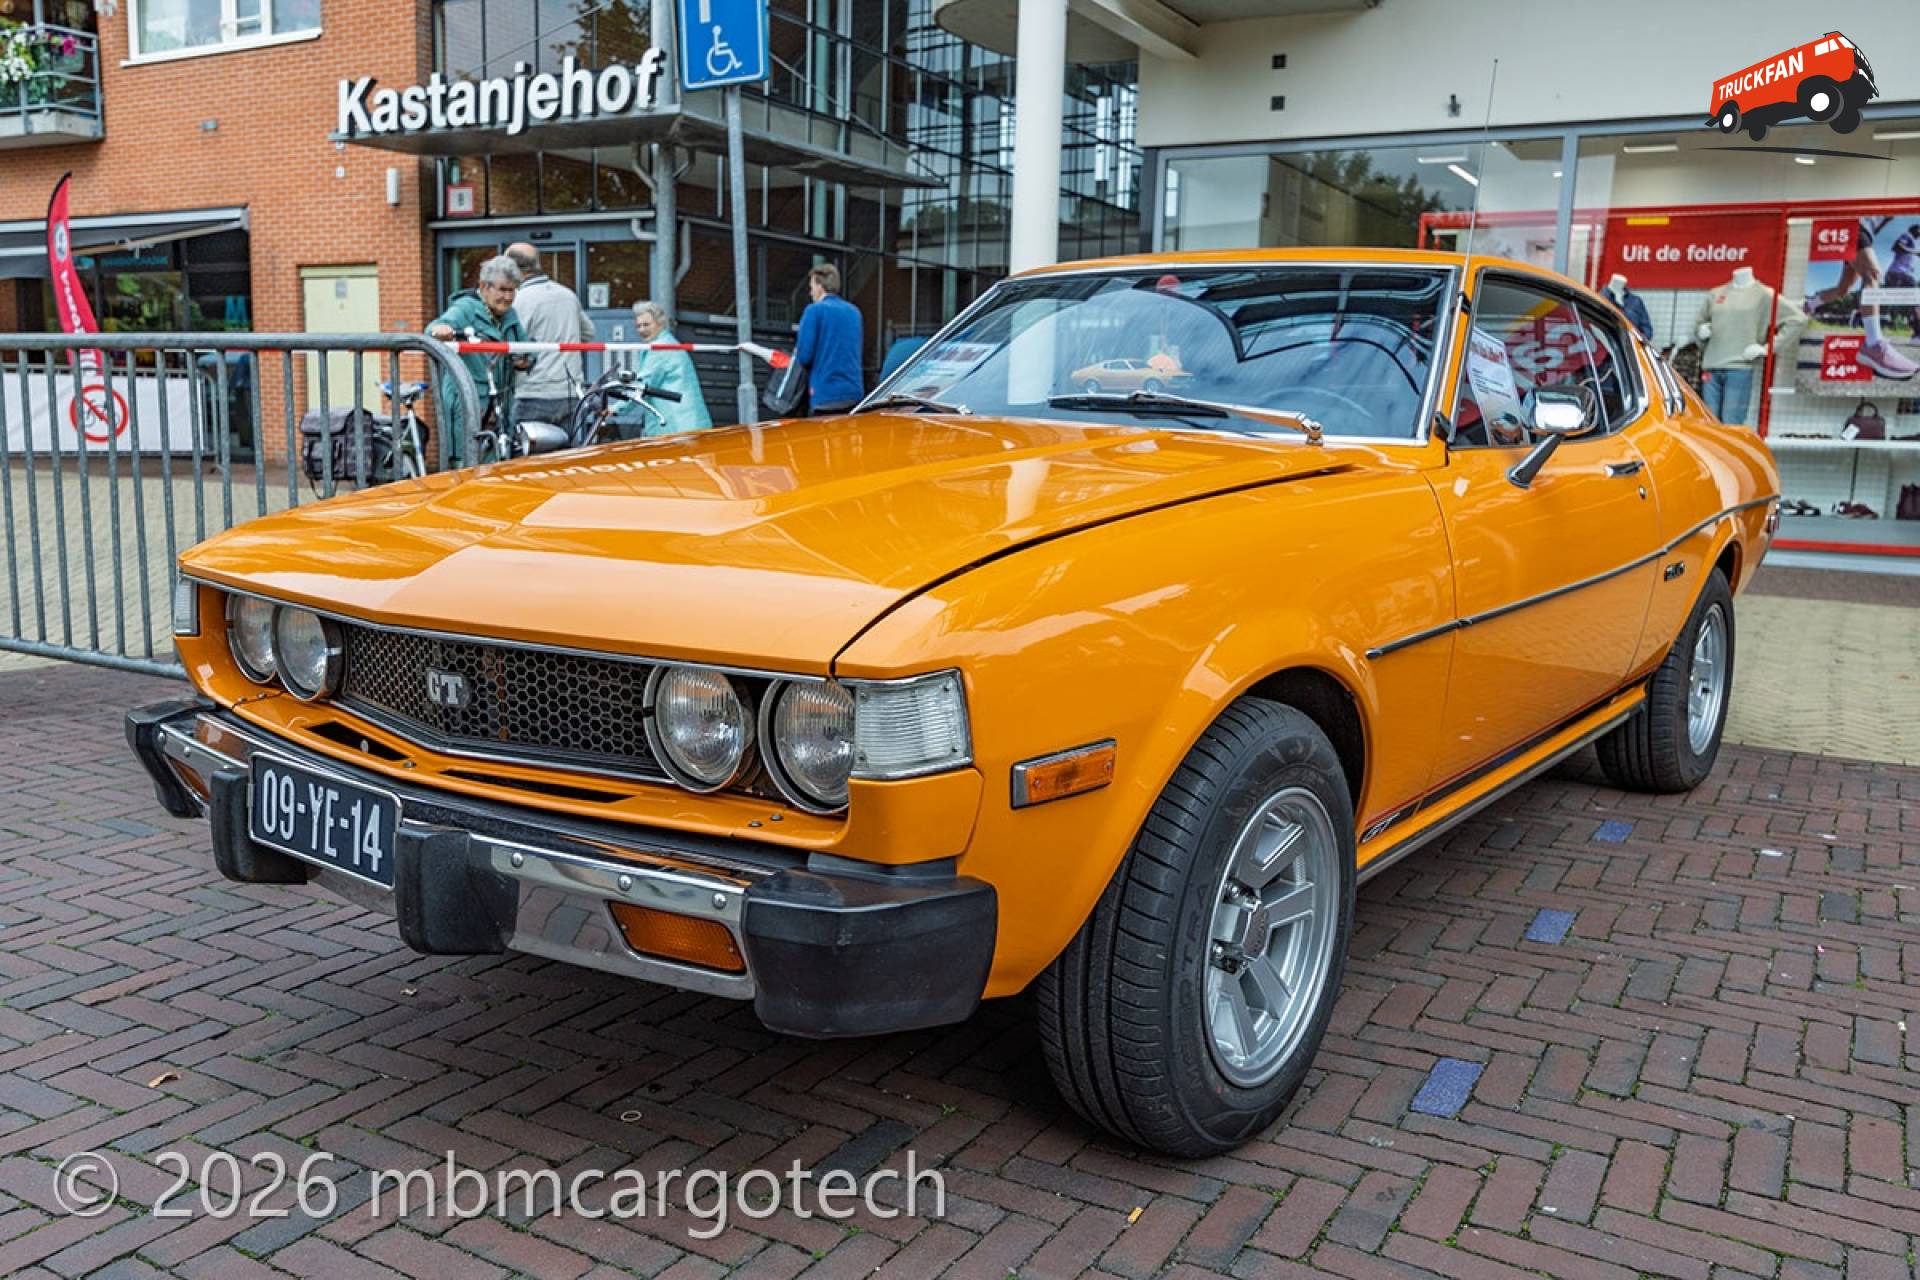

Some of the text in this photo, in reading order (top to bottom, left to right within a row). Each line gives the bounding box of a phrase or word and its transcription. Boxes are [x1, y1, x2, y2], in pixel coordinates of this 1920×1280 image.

[337, 47, 662, 136] Kastanjehof
[1623, 243, 1748, 262] Uit de folder
[427, 670, 463, 705] GT
[263, 768, 383, 873] 09-YE-14
